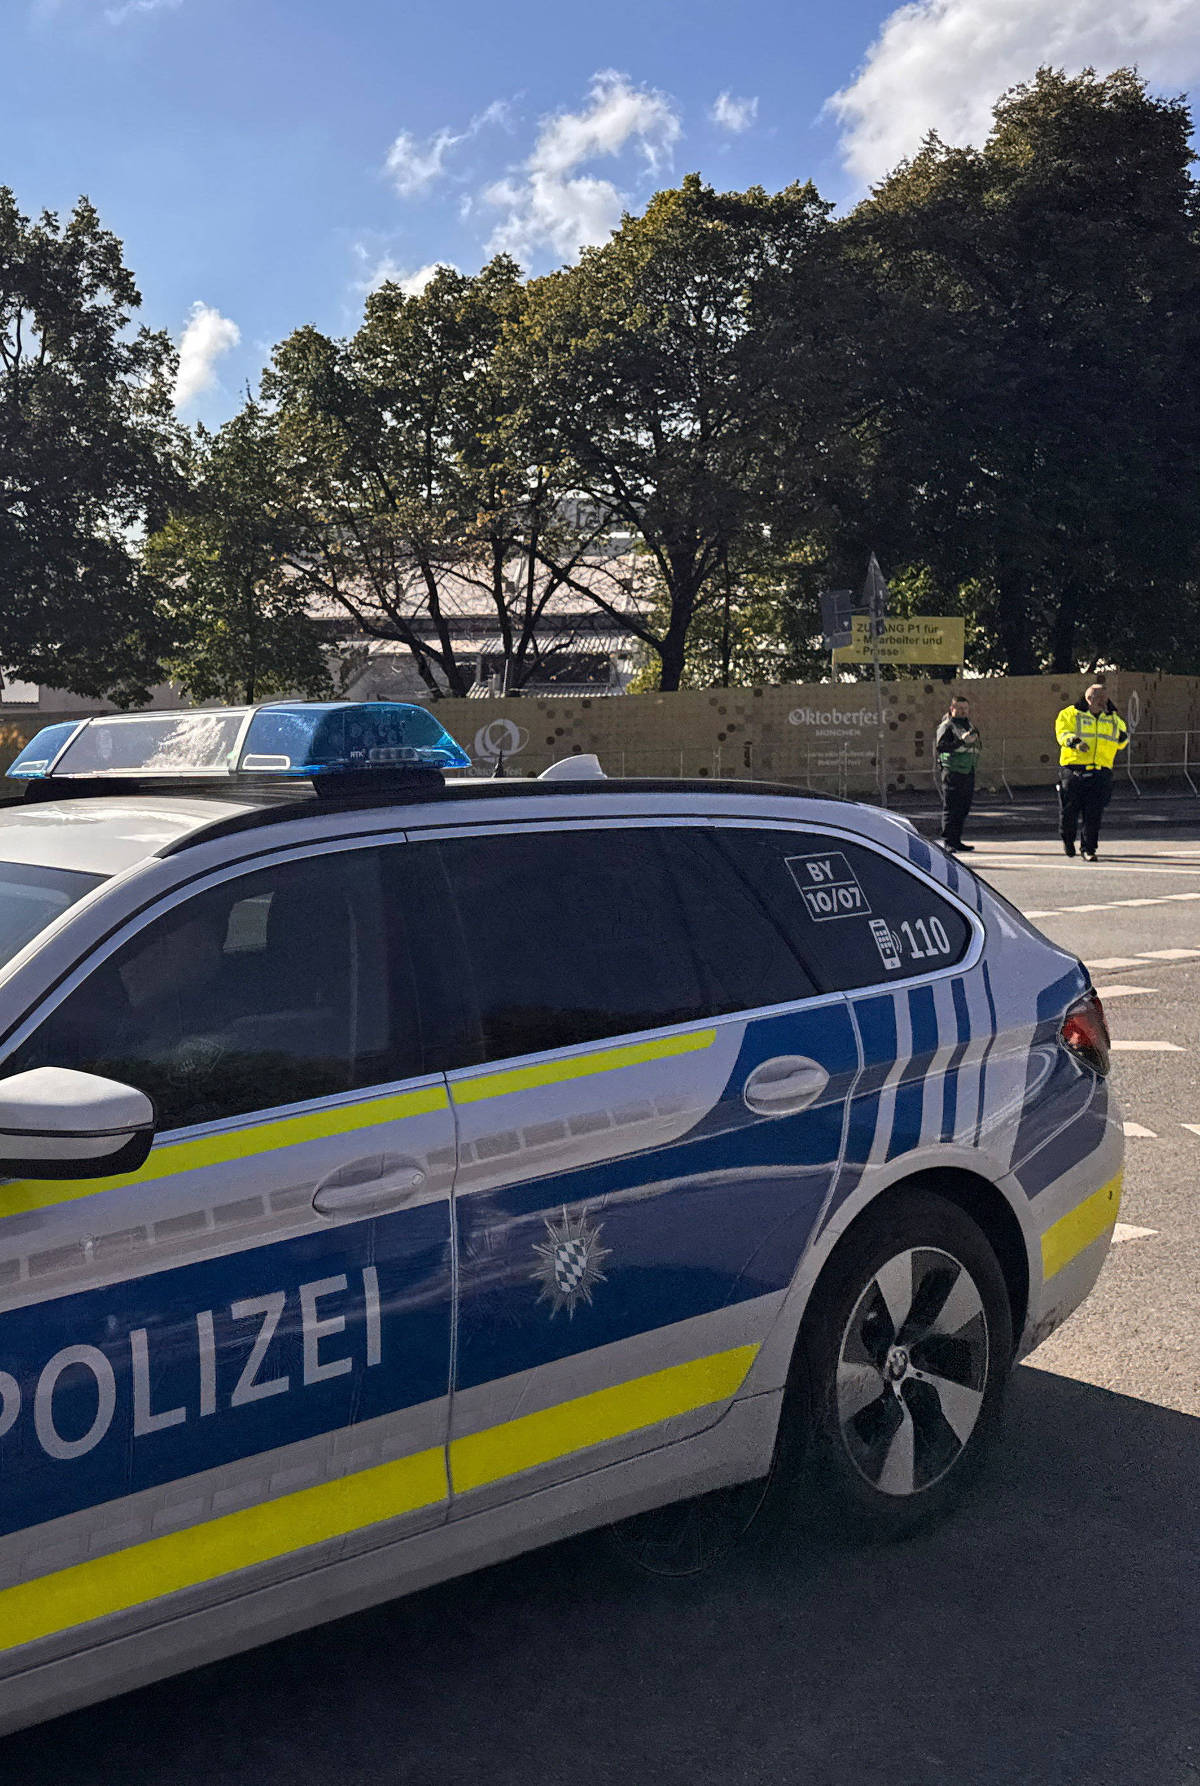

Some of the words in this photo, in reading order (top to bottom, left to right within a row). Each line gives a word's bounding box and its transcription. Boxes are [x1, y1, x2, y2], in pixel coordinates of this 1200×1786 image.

[857, 624, 904, 634] ZUNG
[908, 624, 921, 633] P1
[924, 624, 939, 634] für
[864, 635, 920, 646] Marbeiter
[922, 635, 943, 646] und
[863, 646, 899, 656] Prsse
[806, 860, 835, 882] BY
[806, 887, 863, 913] 10/07
[901, 916, 951, 959] 110
